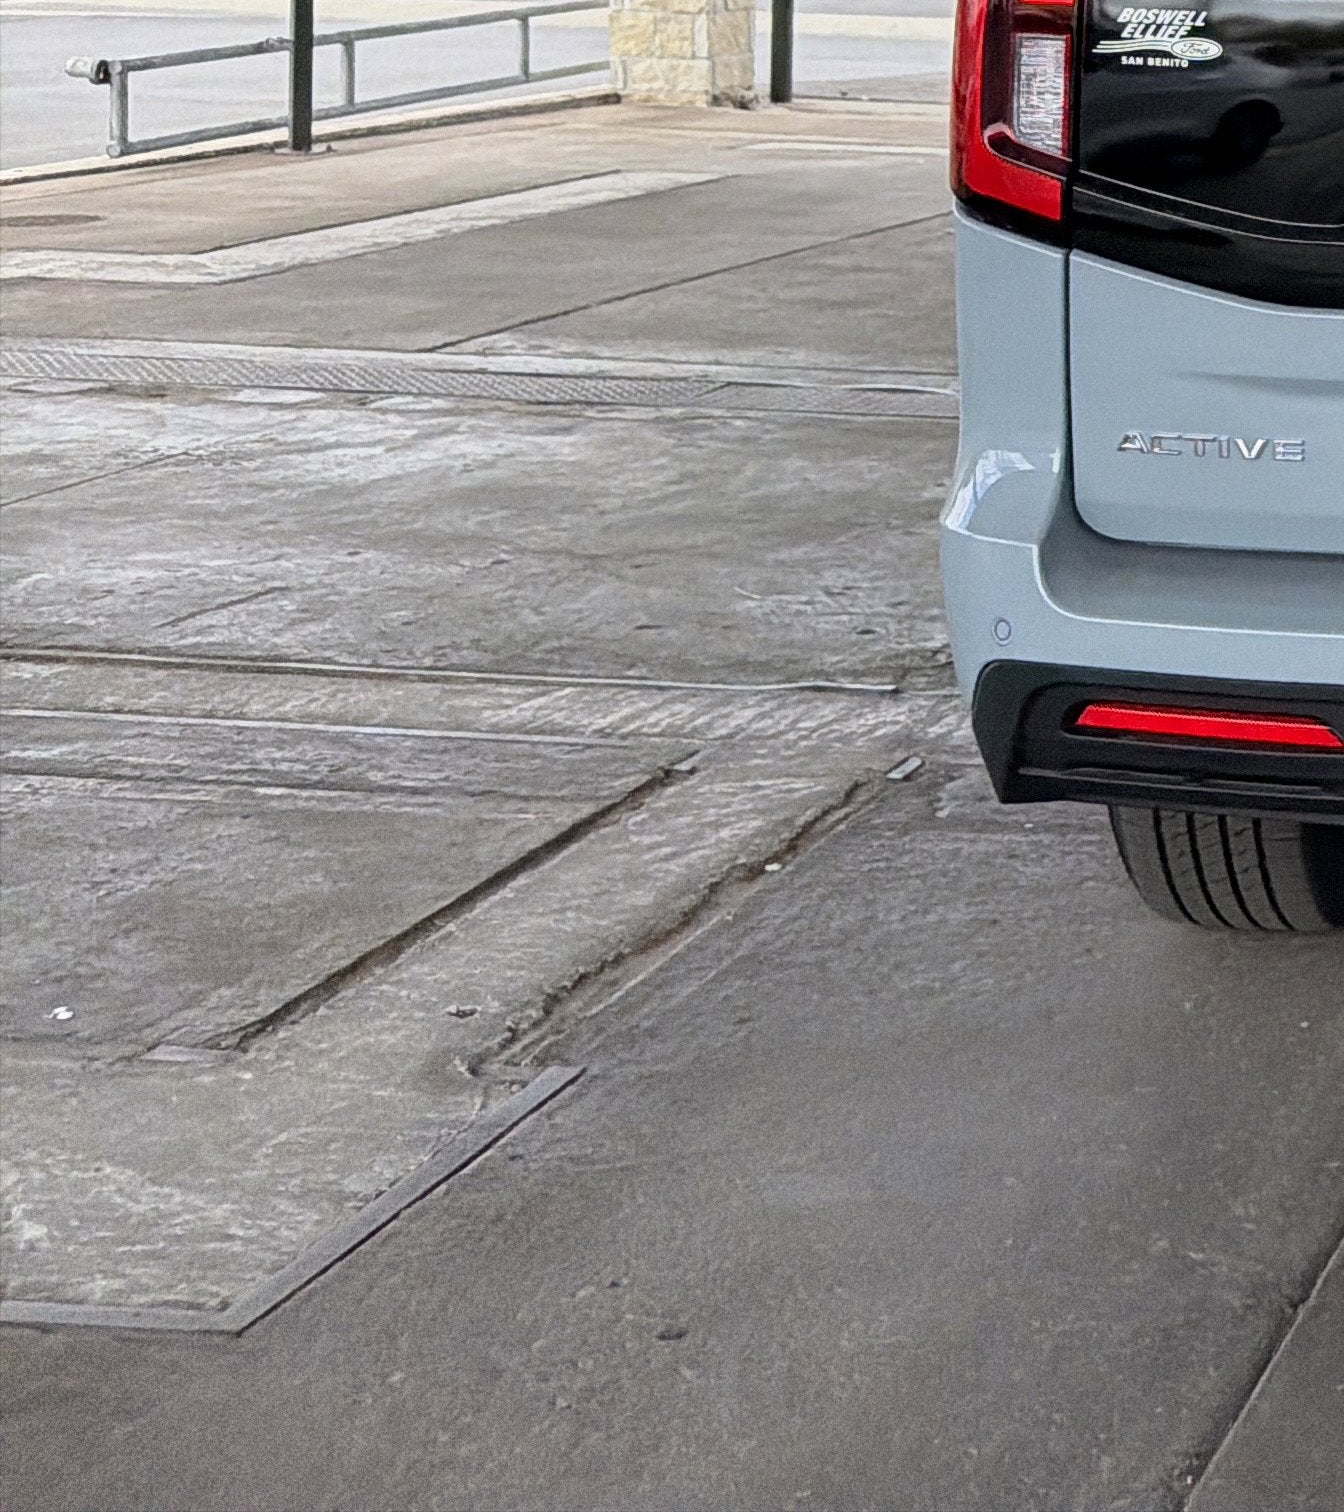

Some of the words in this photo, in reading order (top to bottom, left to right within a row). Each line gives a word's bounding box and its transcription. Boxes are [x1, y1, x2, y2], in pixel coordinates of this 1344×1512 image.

[1116, 7, 1208, 27] BOSWELL
[1120, 23, 1192, 40] ELLIFF
[1180, 42, 1210, 55] Ford
[1120, 55, 1144, 66] SAN
[1147, 57, 1189, 68] BENITO
[1117, 430, 1306, 462] ACTIVE
